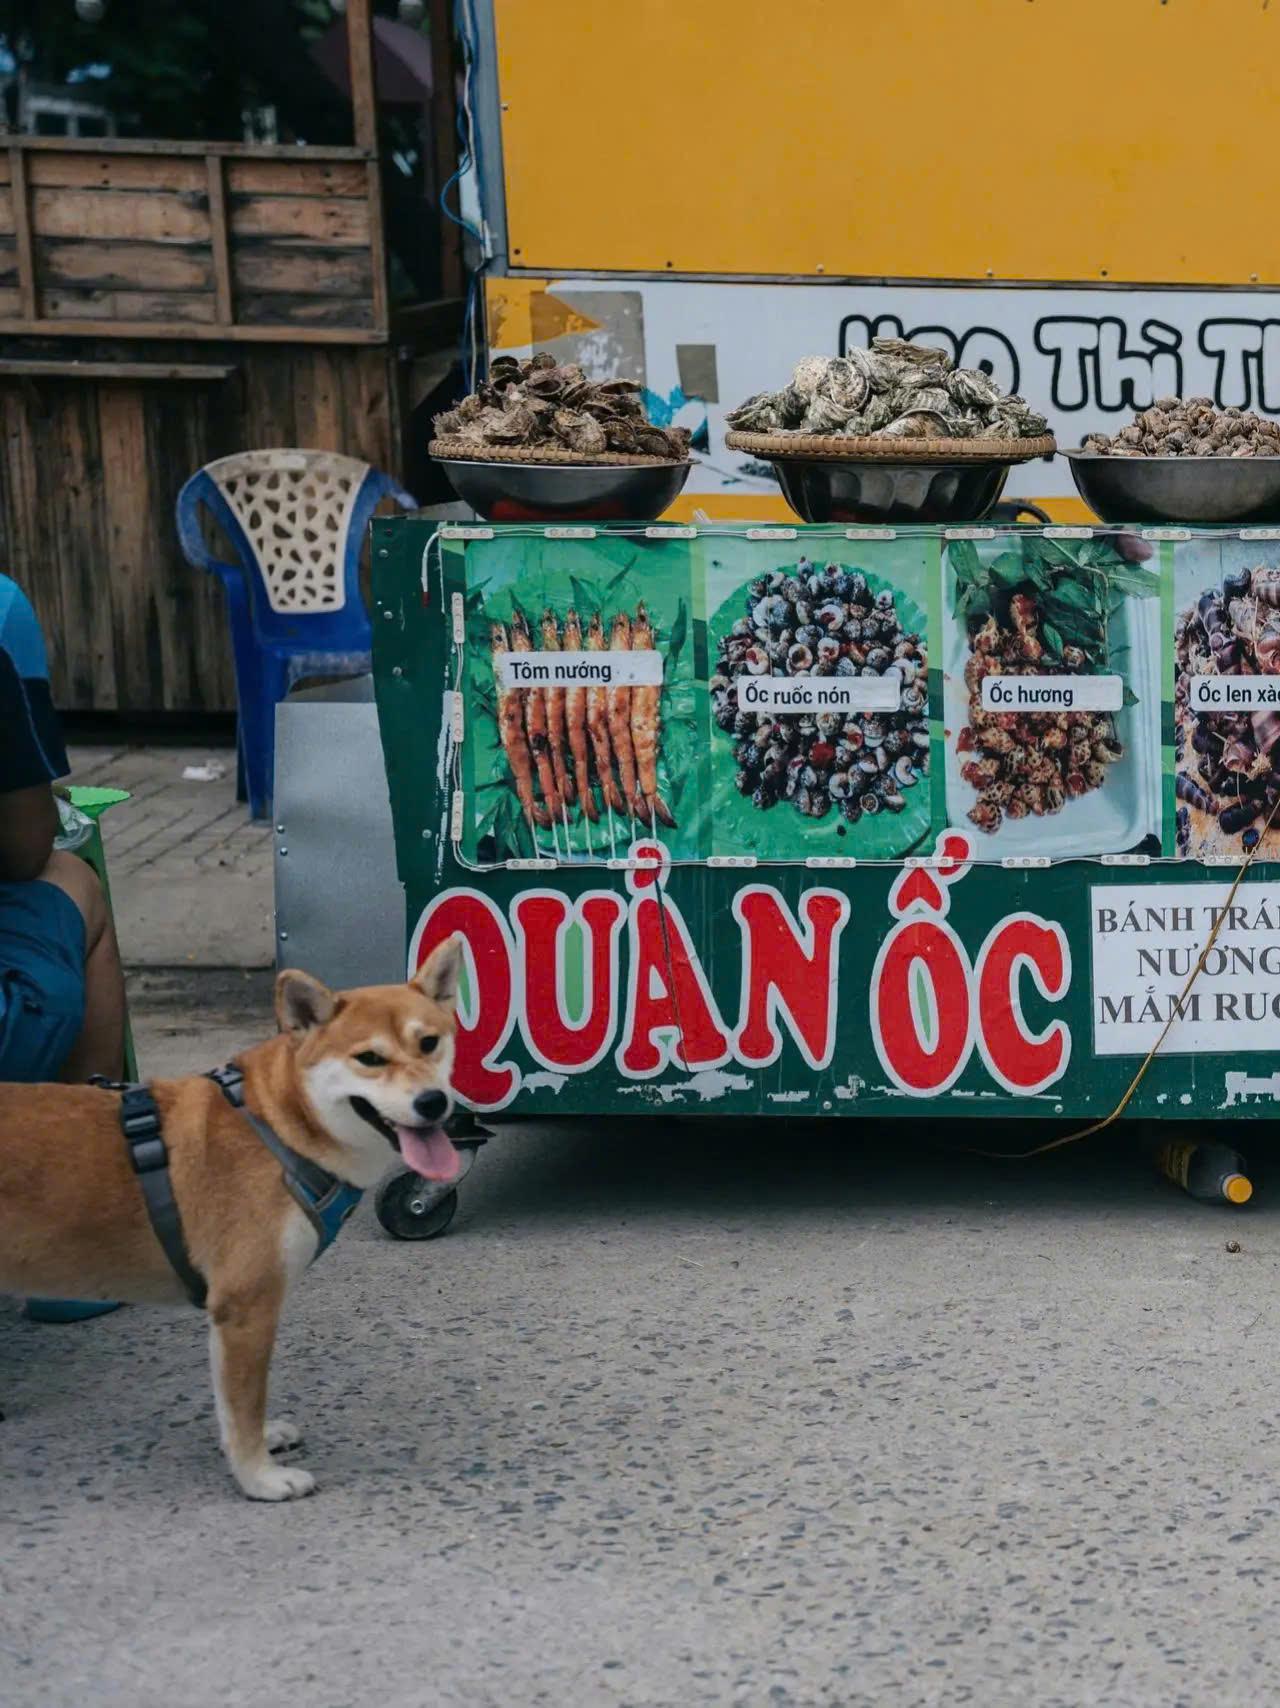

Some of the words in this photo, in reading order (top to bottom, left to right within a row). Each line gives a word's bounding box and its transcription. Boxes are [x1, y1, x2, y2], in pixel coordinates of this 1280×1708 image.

[509, 662, 550, 680] Tôm
[554, 661, 612, 682] nướng
[745, 680, 769, 704] Ốc
[773, 685, 813, 705] ruốc
[817, 686, 850, 704] nón
[989, 680, 1013, 703] Ốc
[1017, 685, 1074, 707] hương
[1198, 680, 1222, 703] Ốc
[1226, 685, 1252, 702] len
[1097, 900, 1195, 933] BÁNH
[409, 840, 850, 1111] QUÁN
[870, 828, 1072, 1097] ỐC
[1099, 985, 1203, 1024] MẮM
